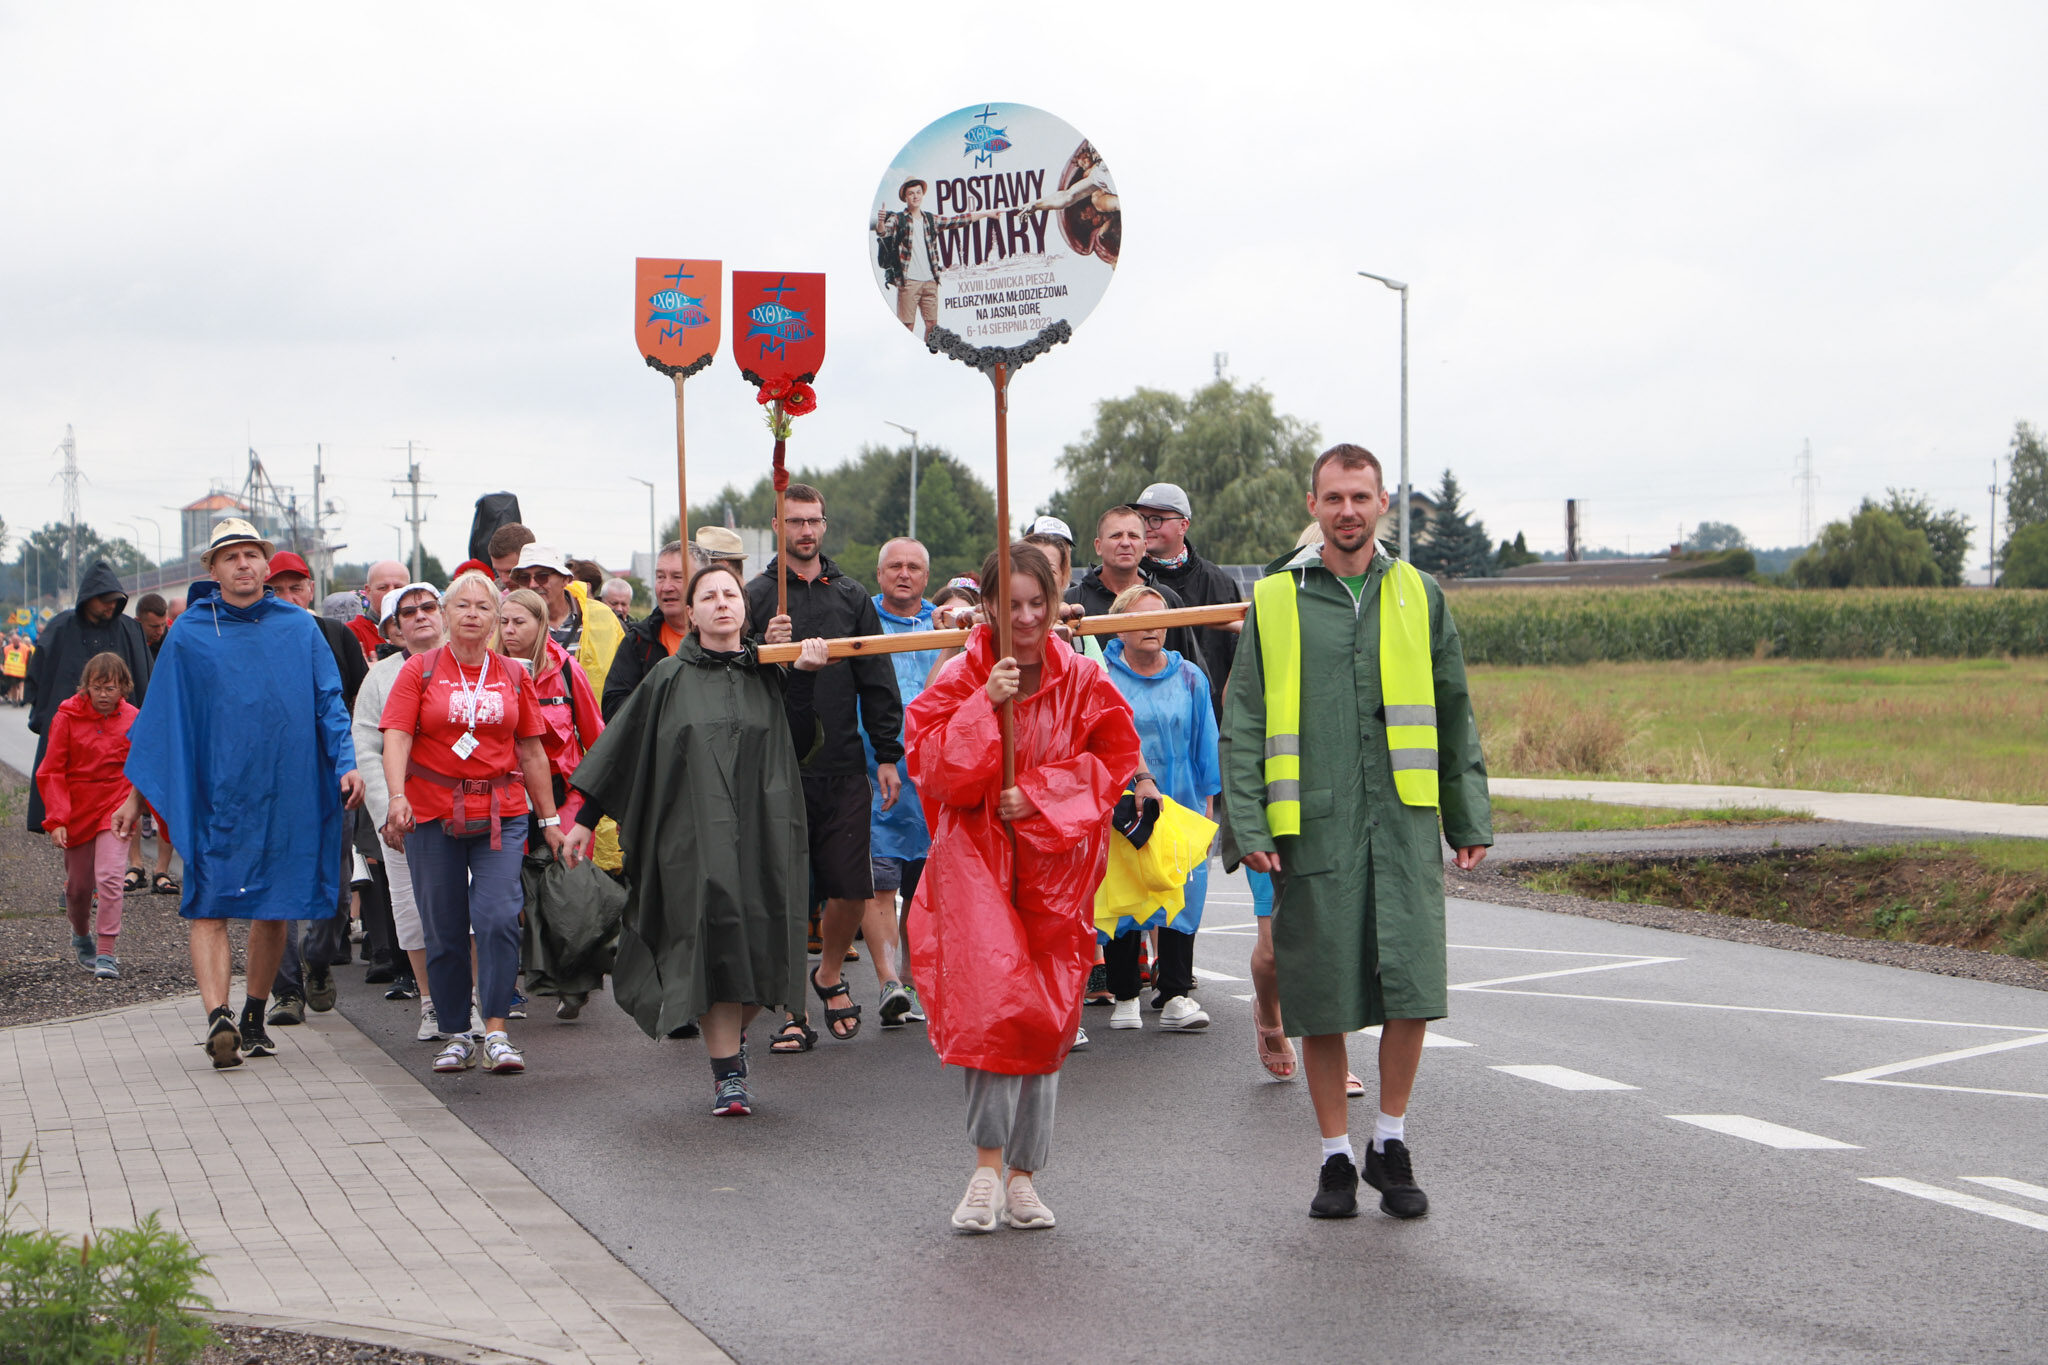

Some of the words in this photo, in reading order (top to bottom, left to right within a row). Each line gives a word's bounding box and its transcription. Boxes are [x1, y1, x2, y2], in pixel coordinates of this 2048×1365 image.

[936, 208, 1049, 268] WIARY
[957, 279, 984, 293] XXVIII
[985, 274, 1024, 291] ŁOWICKA
[1025, 272, 1056, 285] PIESZA
[944, 292, 1005, 309] PIELGRZYMKA
[1006, 284, 1068, 302] MŁODZIEŻOWA
[976, 308, 988, 321] NA
[990, 305, 1017, 319] JASNĄ
[1018, 302, 1041, 315] GÓRĘ
[989, 320, 1028, 335] SIERPNIA
[1029, 317, 1052, 330] 2023
